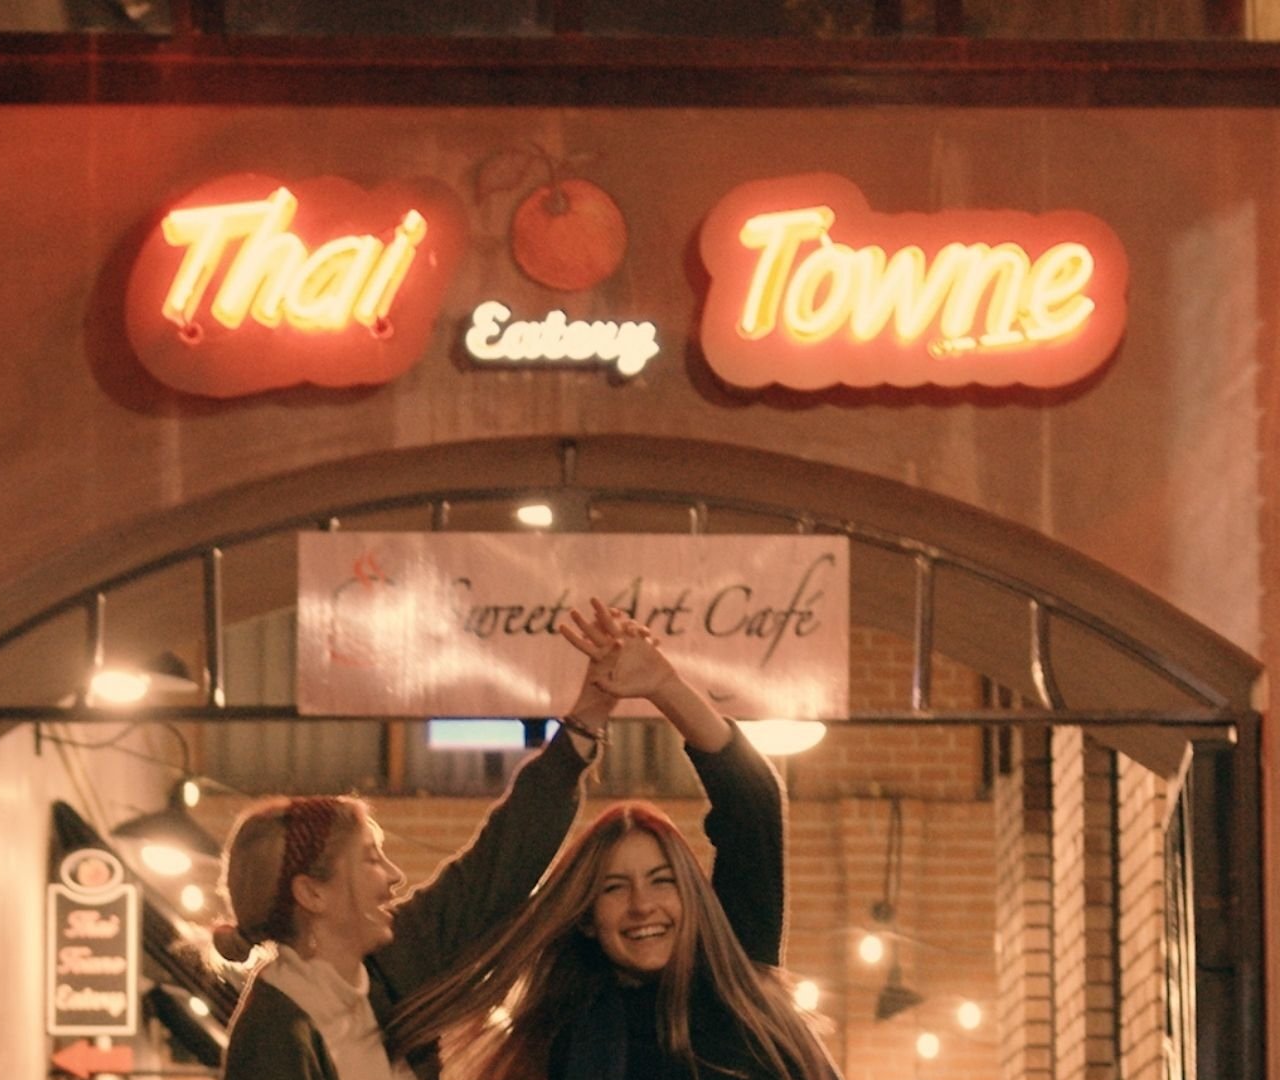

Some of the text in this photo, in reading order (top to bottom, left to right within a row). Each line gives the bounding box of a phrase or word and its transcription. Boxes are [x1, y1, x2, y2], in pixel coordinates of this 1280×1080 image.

[160, 186, 1096, 350] Thai Towne
[464, 299, 661, 378] Eatery
[606, 575, 693, 637] Art
[703, 552, 836, 668] Café
